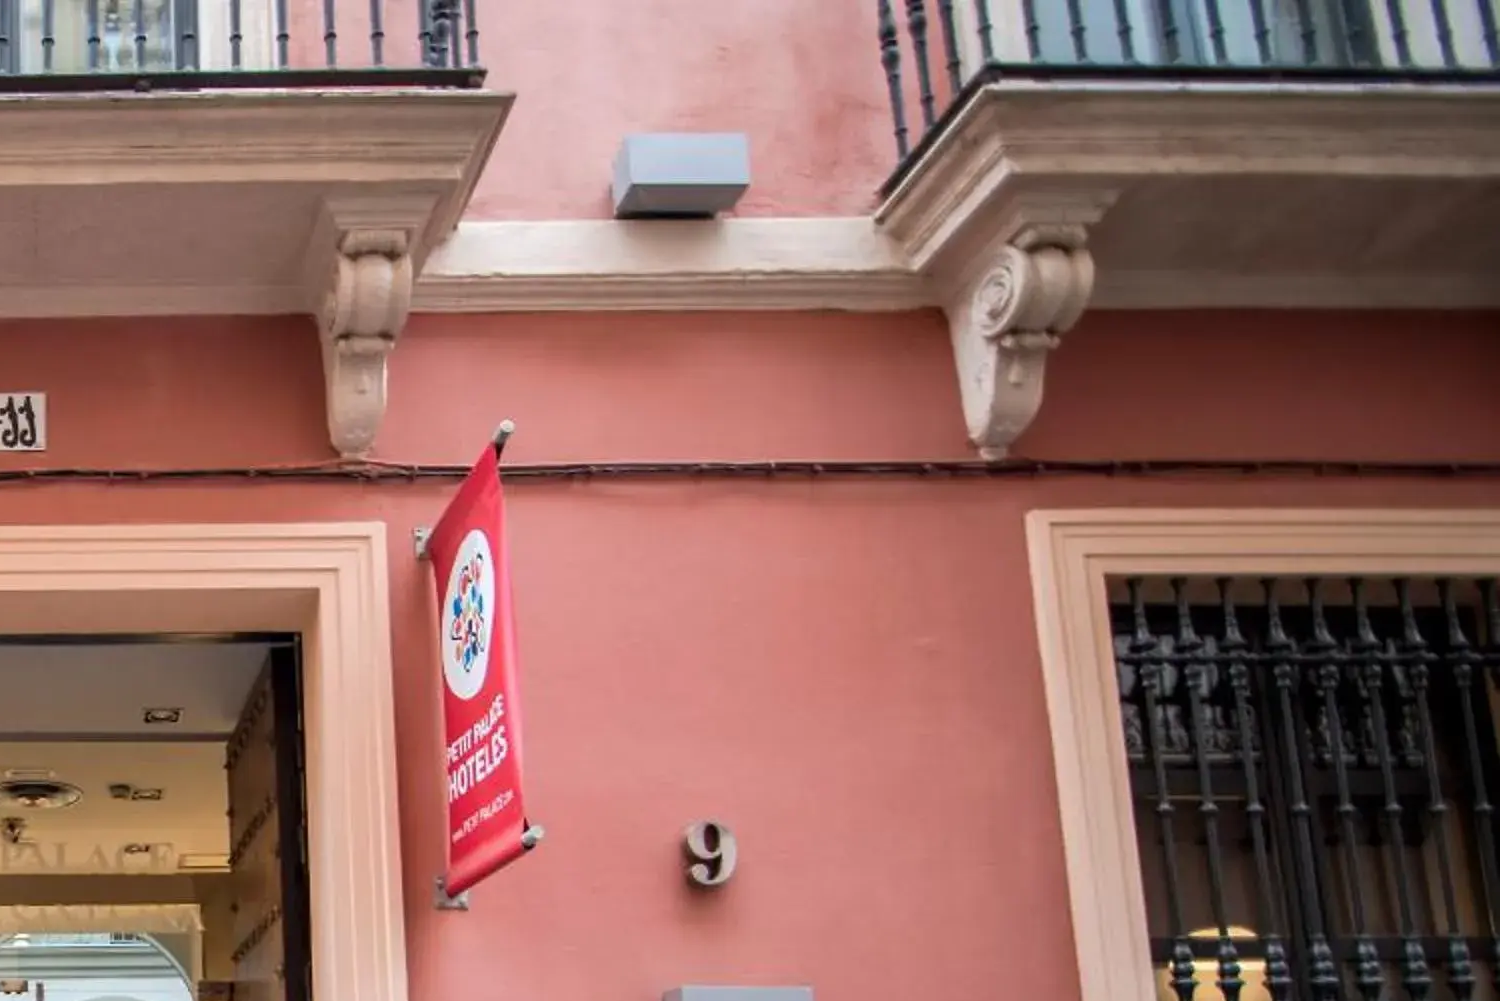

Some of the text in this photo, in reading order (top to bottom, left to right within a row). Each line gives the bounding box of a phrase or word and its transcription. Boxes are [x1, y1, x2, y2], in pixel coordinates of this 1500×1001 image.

[447, 693, 504, 765] PETIT PALACE
[448, 725, 508, 803] HOTELES
[0, 841, 176, 872] PALACE
[684, 820, 737, 885] 9
